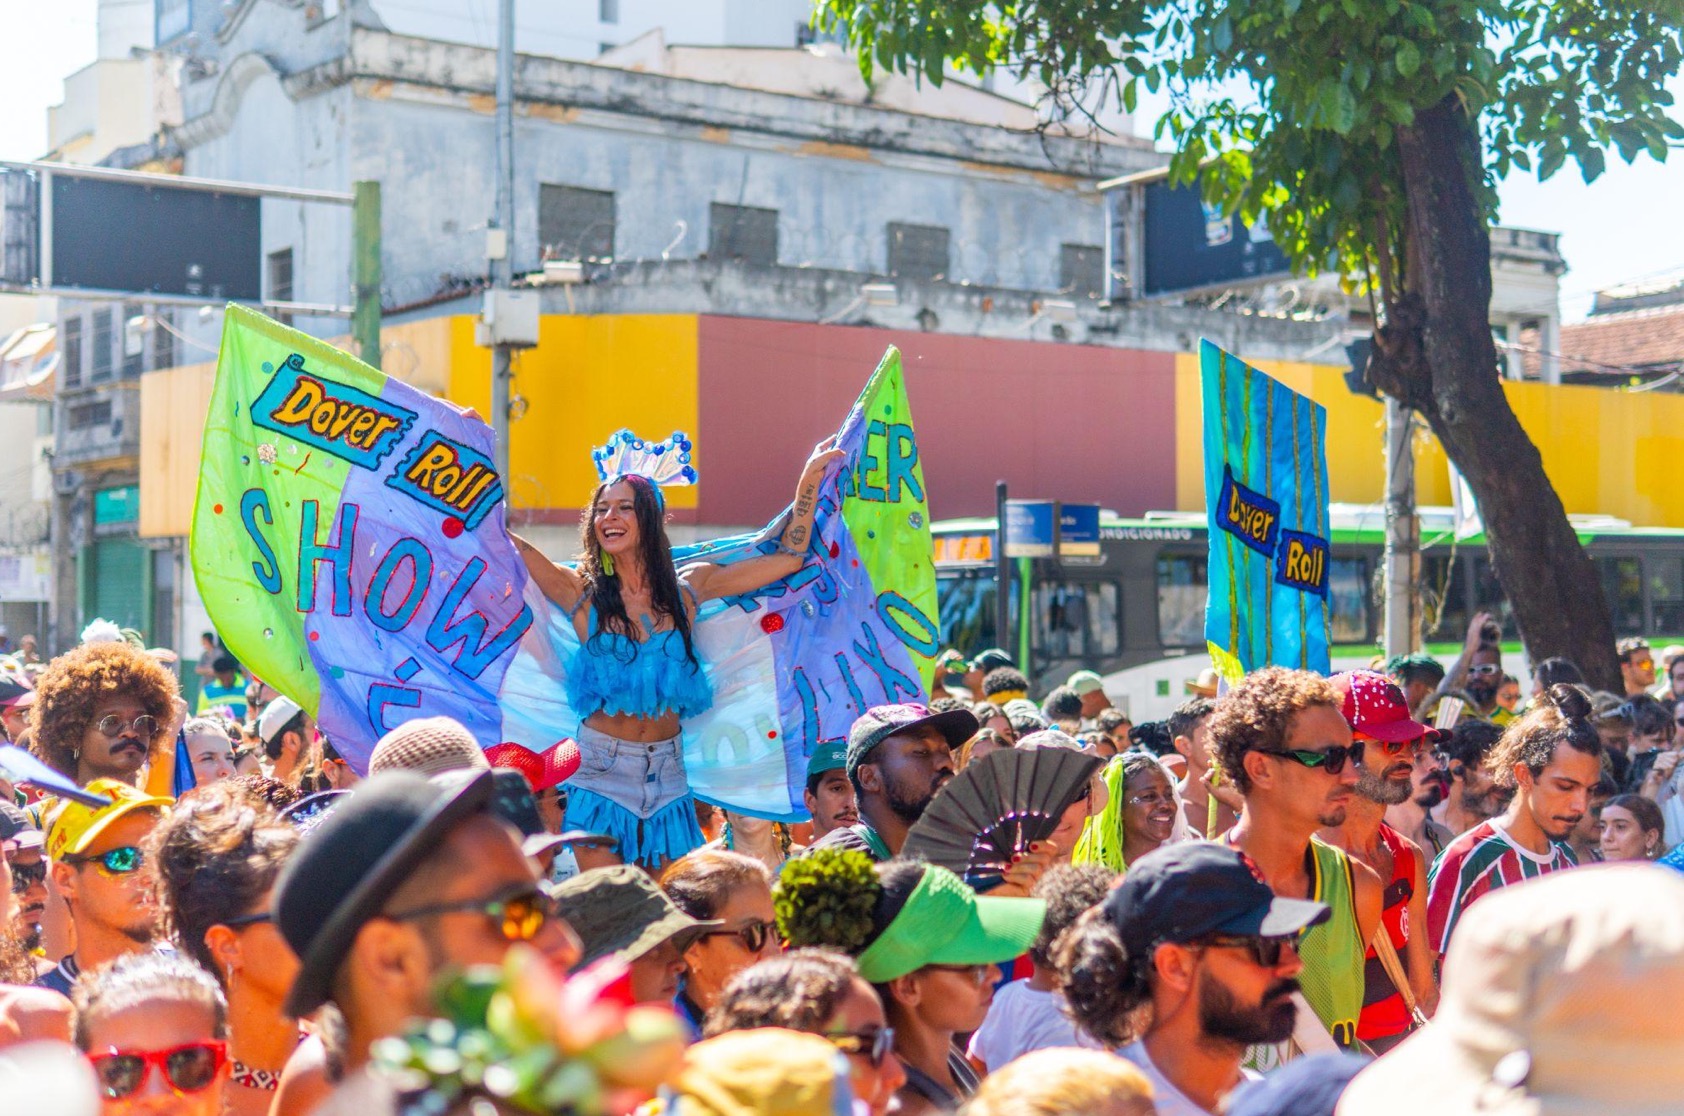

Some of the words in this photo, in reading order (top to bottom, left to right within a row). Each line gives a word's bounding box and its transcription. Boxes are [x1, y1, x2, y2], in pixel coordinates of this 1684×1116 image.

[271, 376, 402, 452] Dover
[405, 441, 499, 512] Roll
[240, 488, 534, 681] SHOW
[1285, 539, 1324, 587] Roll
[793, 590, 940, 758] LIXO
